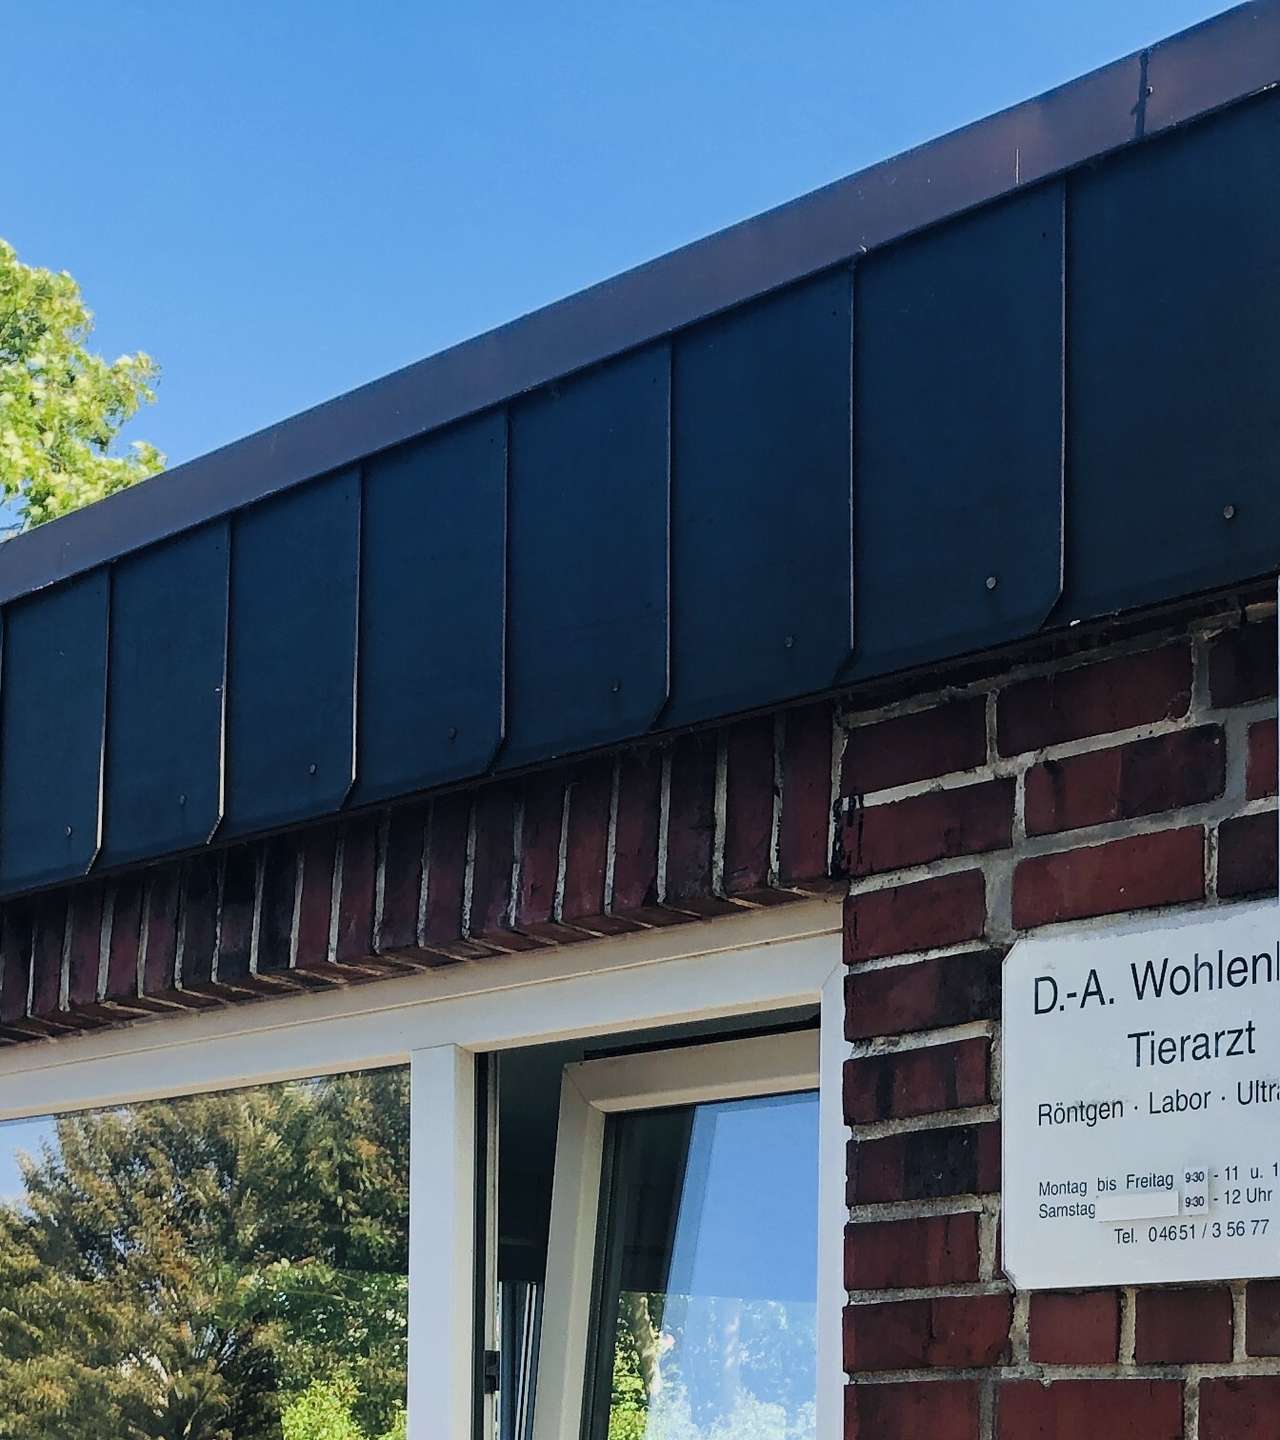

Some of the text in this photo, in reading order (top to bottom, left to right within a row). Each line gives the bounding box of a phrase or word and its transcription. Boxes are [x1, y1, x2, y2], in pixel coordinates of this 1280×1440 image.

[1034, 940, 1280, 1015] D.-A. Wohlen
[1127, 1020, 1256, 1067] Tierarzt
[1038, 1100, 1124, 1127] Röntgen
[1149, 1089, 1211, 1114] Labor
[1039, 1180, 1087, 1197] Montag
[1097, 1177, 1117, 1192] bis
[1126, 1172, 1174, 1190] Freitag
[1224, 1165, 1238, 1181] 11
[1250, 1167, 1263, 1180] u.
[1039, 1202, 1096, 1219] Samstag
[1224, 1189, 1241, 1205] 12
[1246, 1187, 1273, 1204] Uhr
[1114, 1227, 1138, 1244] Tel.
[1148, 1223, 1195, 1242] 04651
